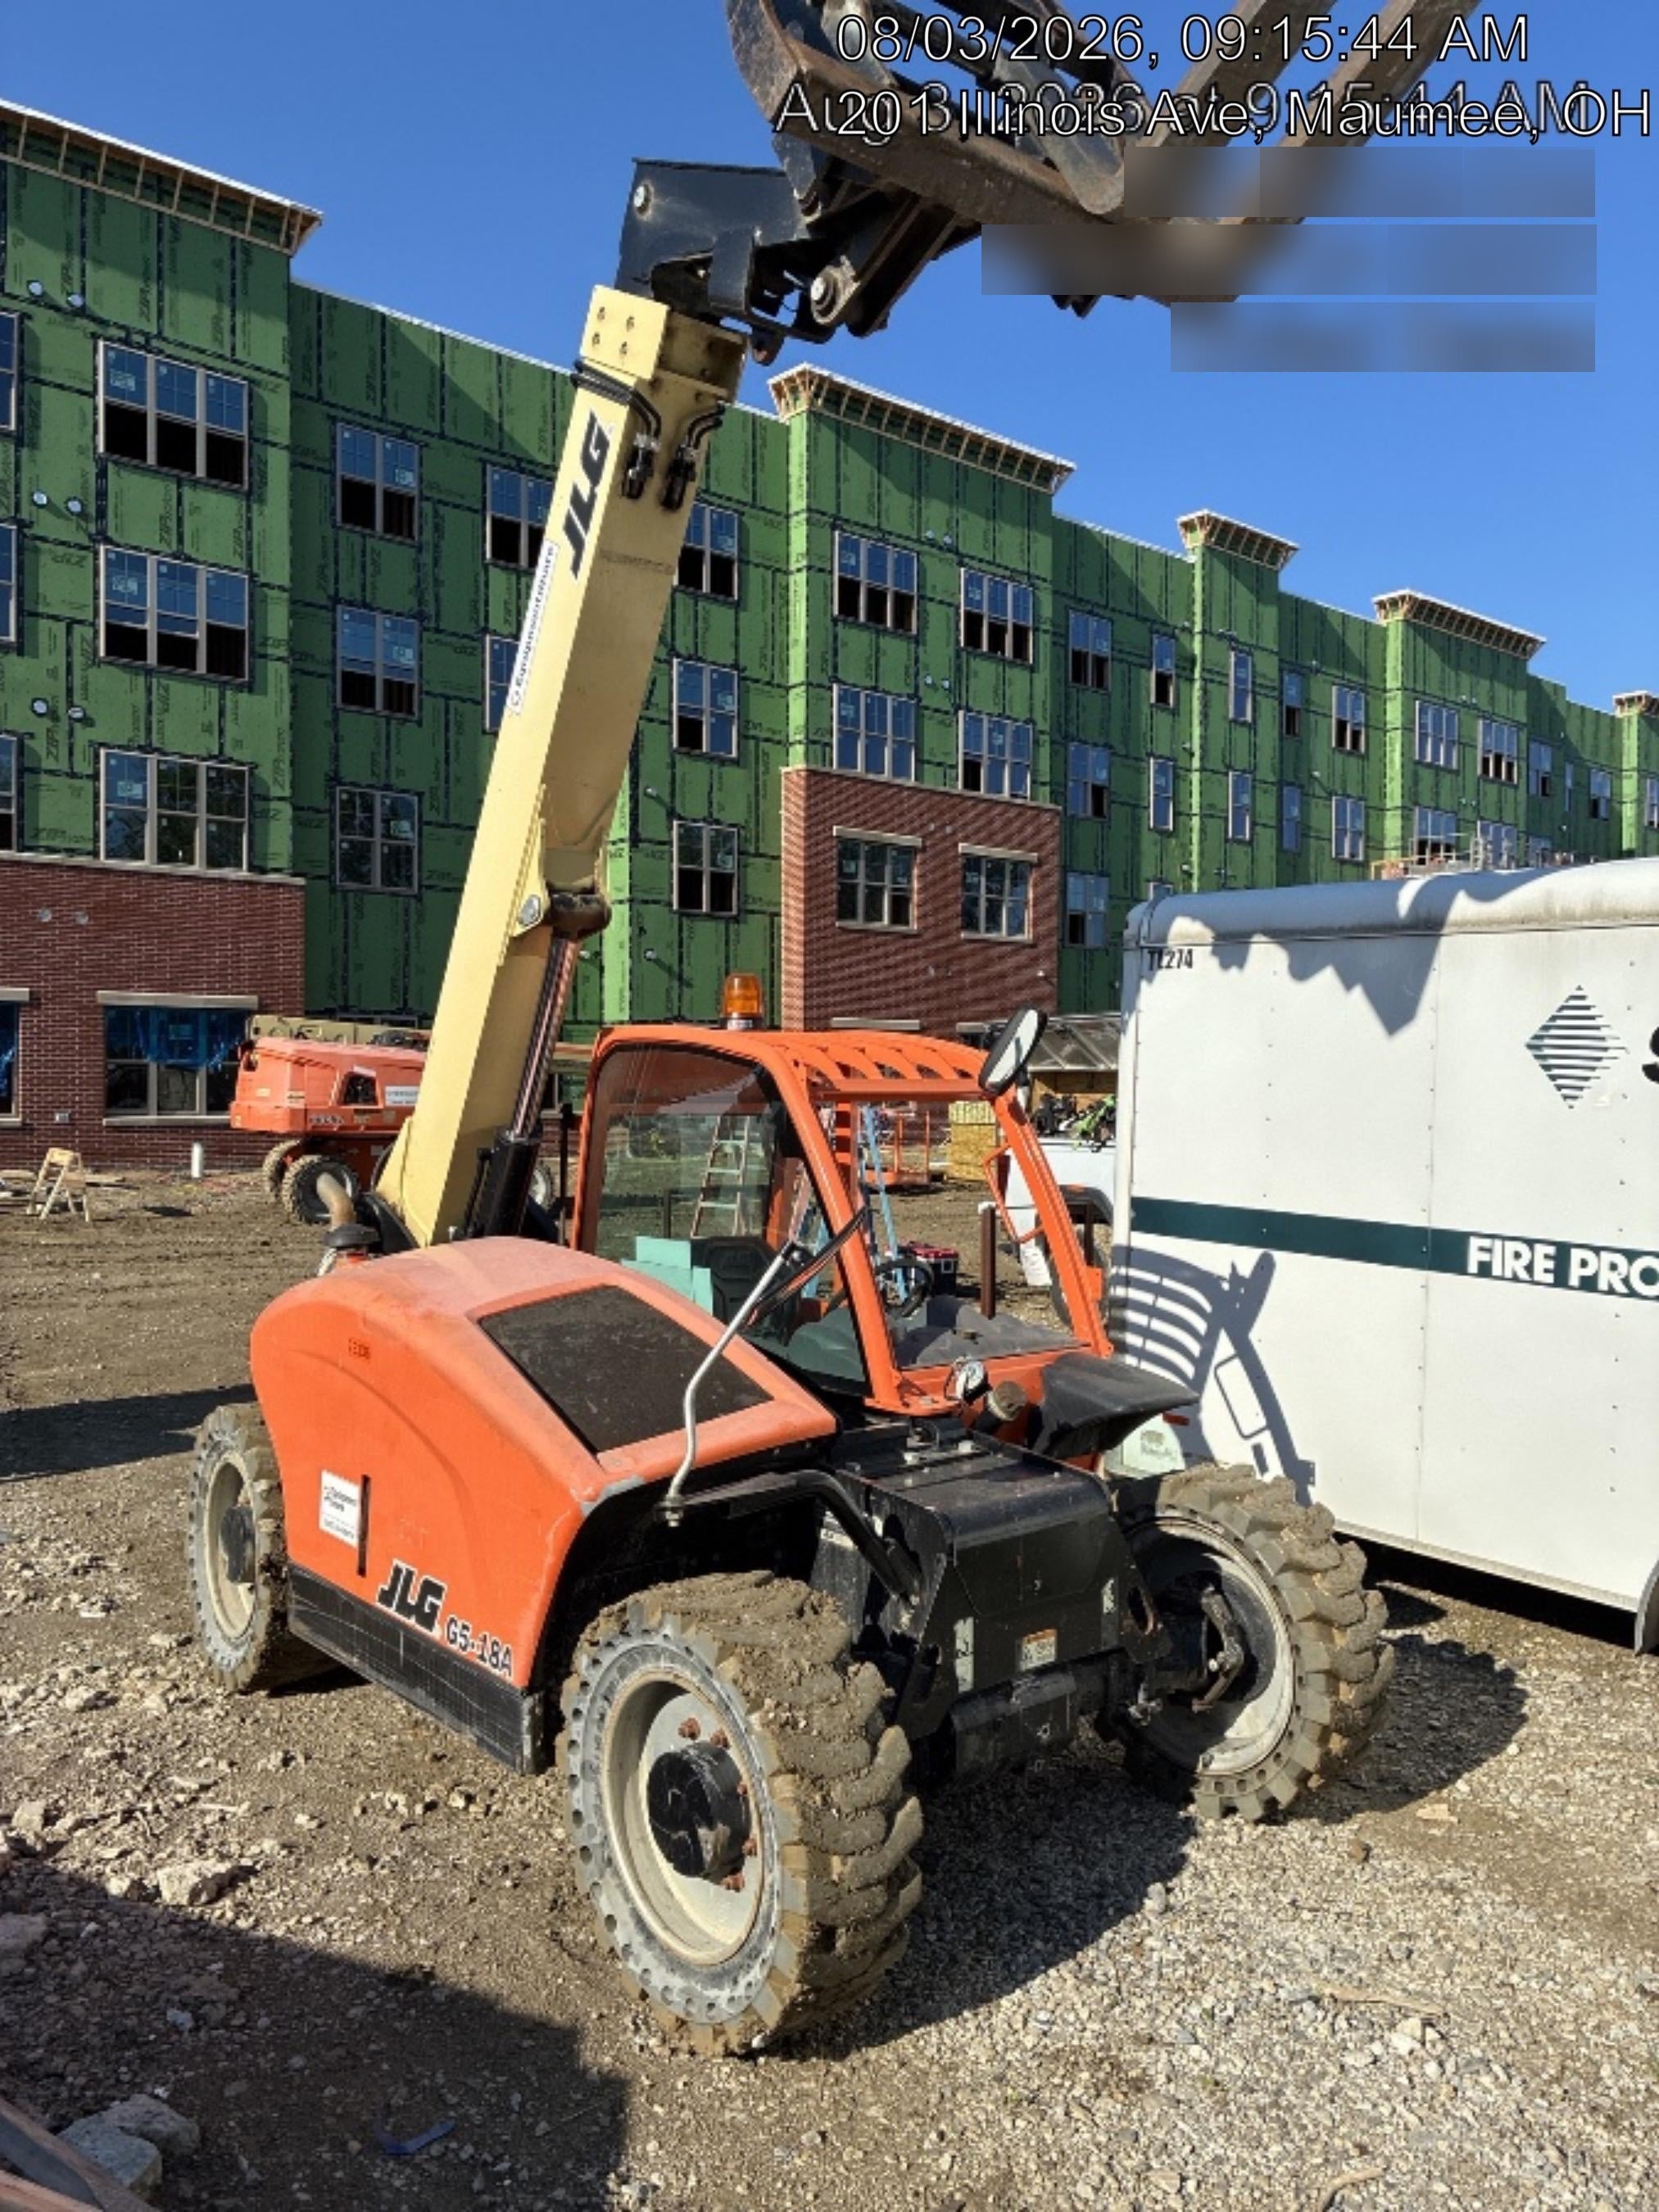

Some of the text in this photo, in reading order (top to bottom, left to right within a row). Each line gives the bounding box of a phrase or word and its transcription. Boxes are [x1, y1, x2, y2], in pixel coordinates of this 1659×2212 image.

[562, 408, 610, 580] JLG
[1466, 1235, 1659, 1298] FIRE PRO
[377, 1559, 446, 1637] JLG
[446, 1616, 514, 1681] G5-18A
